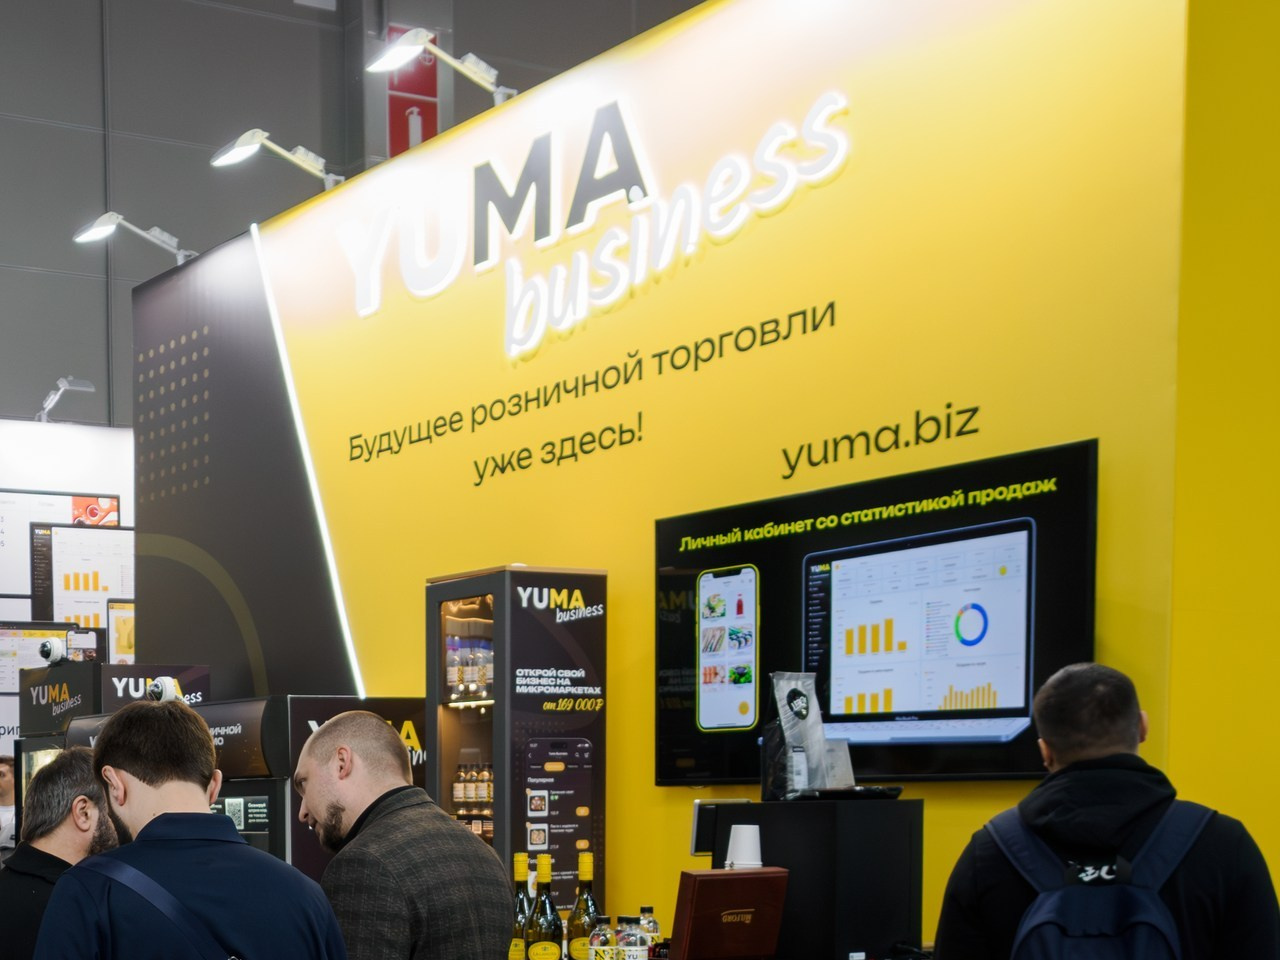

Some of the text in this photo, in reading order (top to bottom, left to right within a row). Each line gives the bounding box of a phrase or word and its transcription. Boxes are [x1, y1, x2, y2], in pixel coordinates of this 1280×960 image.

[336, 100, 648, 317] YUMA
[506, 93, 850, 357] business
[348, 301, 837, 461] Будущее розничной торговли
[473, 412, 644, 486] уже здесь!
[781, 402, 980, 479] yuma.biz
[679, 477, 1057, 552] Личный кабинет со статистикой продаж
[517, 587, 585, 609] YUMA
[556, 604, 604, 623] business
[516, 668, 586, 678] ОТКРОЙ СВОЙ
[516, 677, 555, 685] БИЗНЕС
[30, 683, 69, 705] YUMA
[516, 686, 601, 694] МИКРОМАРКЕТАХ
[52, 694, 82, 716] business
[557, 699, 573, 711] 169
